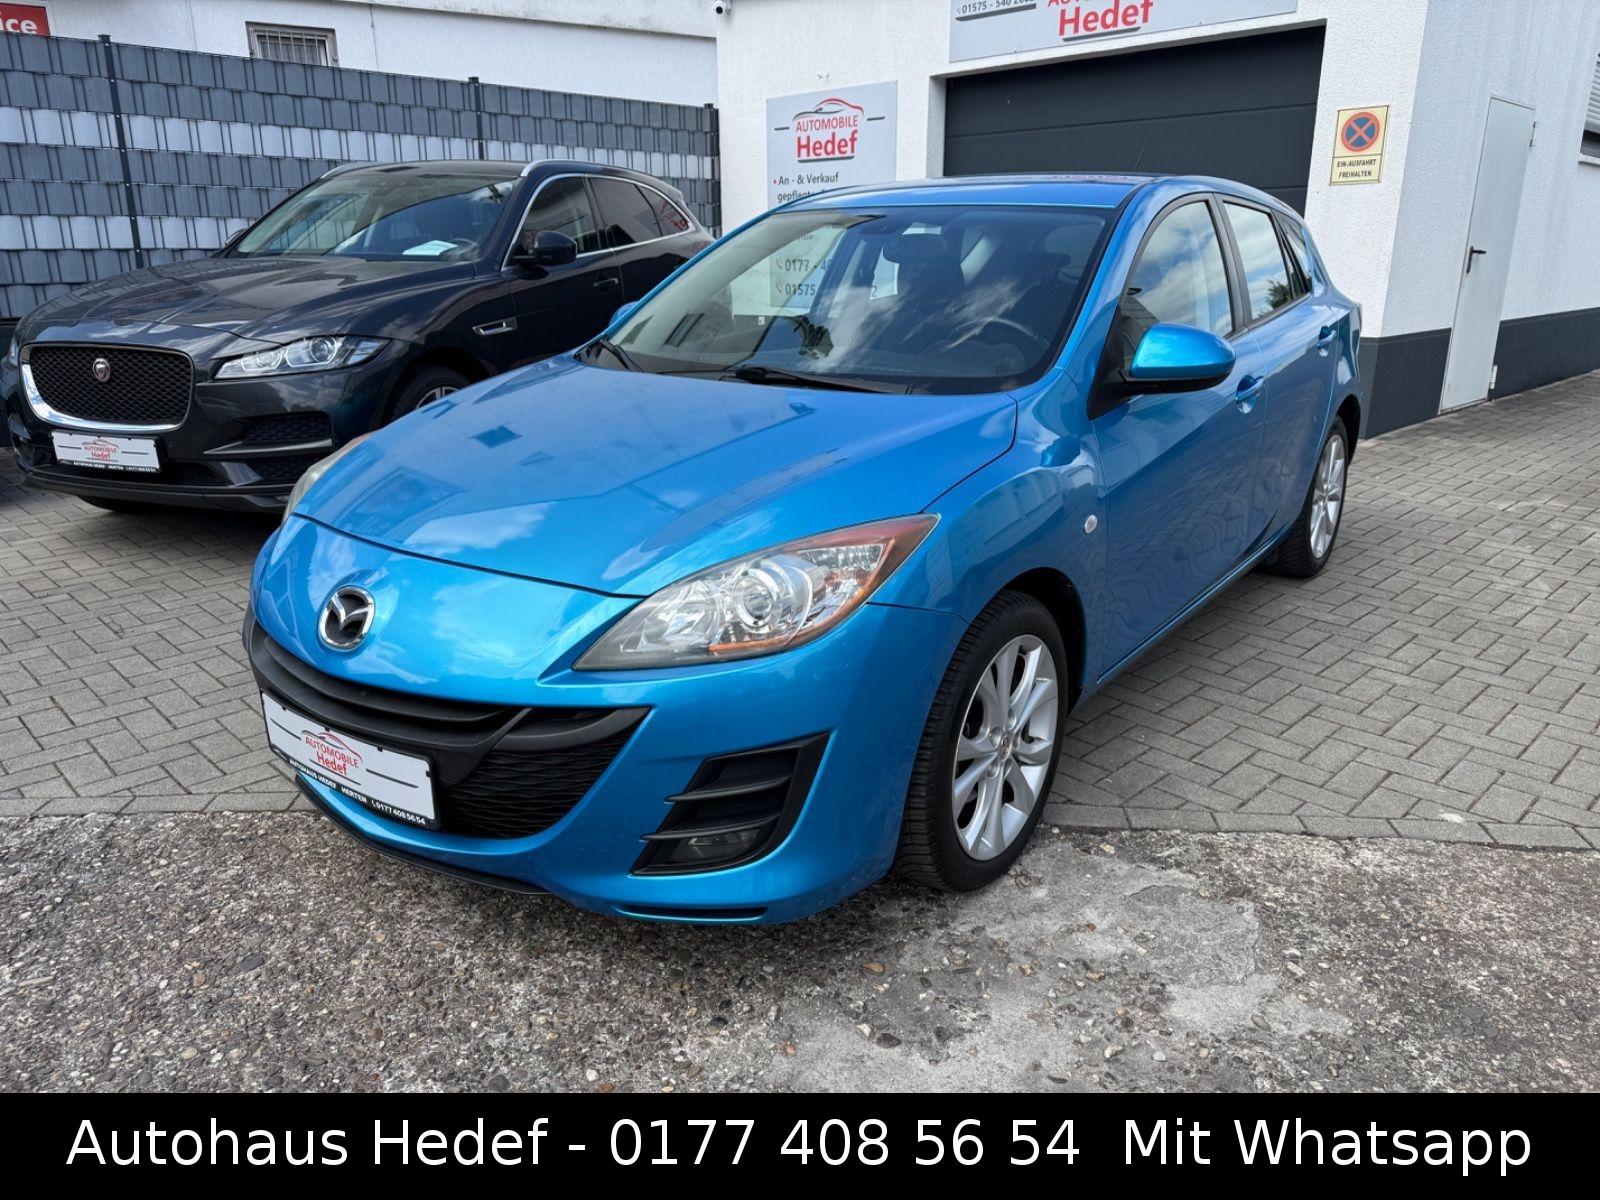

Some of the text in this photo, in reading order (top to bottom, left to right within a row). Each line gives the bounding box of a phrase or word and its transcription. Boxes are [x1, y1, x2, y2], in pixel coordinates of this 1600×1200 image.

[962, 3, 987, 13] 01575
[1059, 0, 1153, 36] Hedef
[796, 115, 858, 132] AUTOMOBILE
[797, 130, 858, 158] Hedef
[778, 176, 789, 185] An
[797, 174, 804, 184] &
[806, 171, 839, 183] Verkauf
[1339, 170, 1371, 178] FREIHALTEN
[784, 259, 810, 272] 0177
[785, 283, 817, 296] 01575
[305, 736, 359, 768] AUTOMOBILE
[317, 752, 347, 776] Hedef
